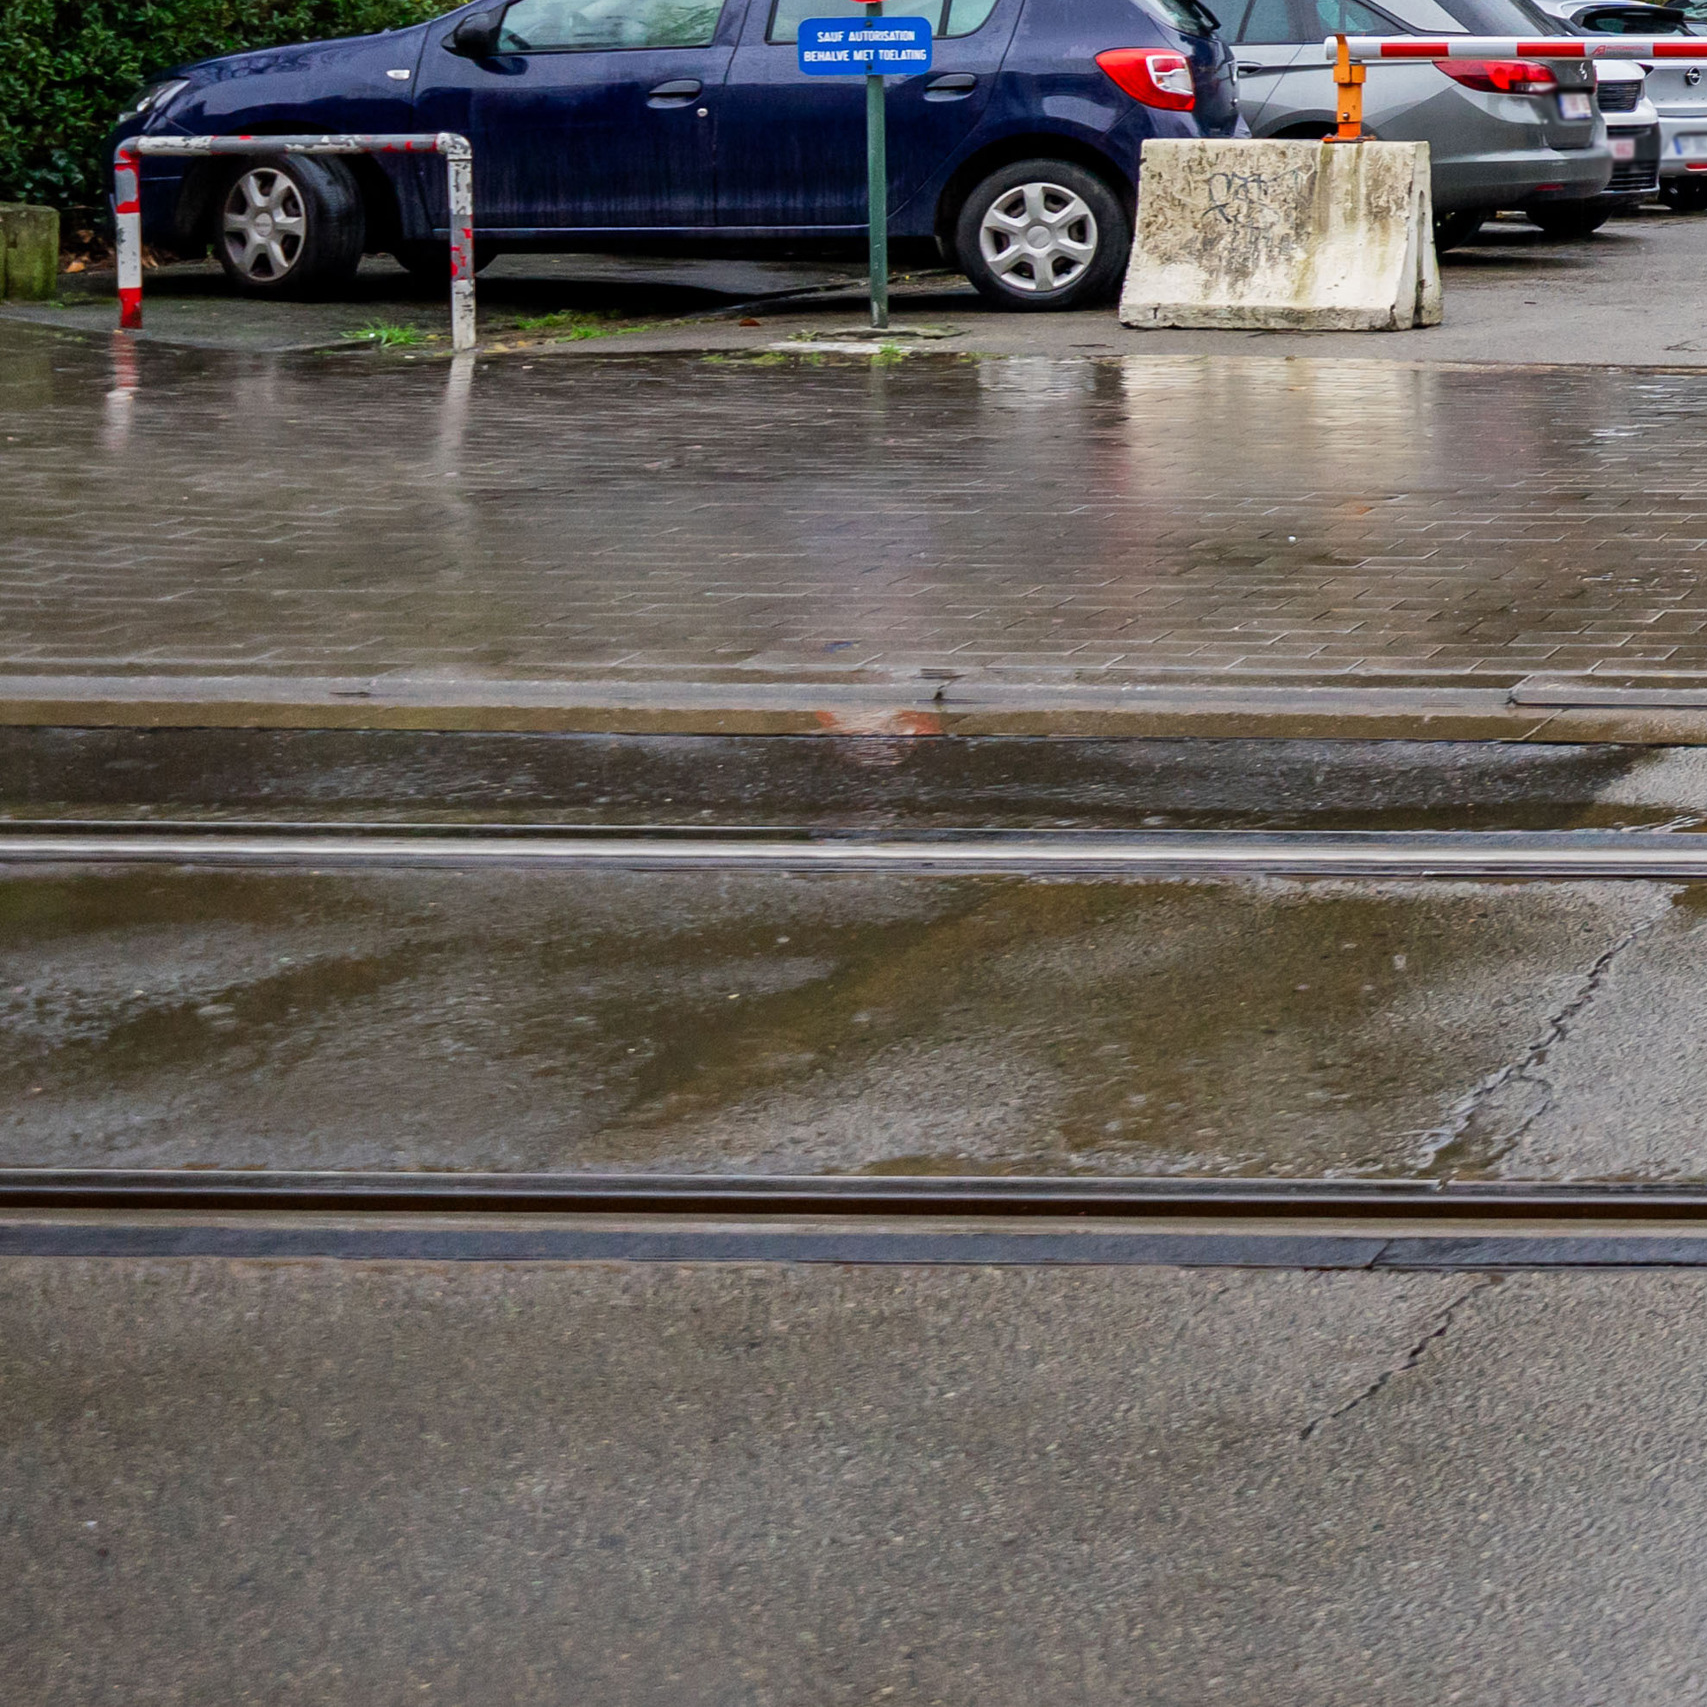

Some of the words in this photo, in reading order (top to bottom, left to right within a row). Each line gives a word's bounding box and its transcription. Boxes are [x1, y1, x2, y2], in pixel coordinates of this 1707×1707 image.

[817, 31, 843, 43] SAUF
[848, 30, 916, 42] AUTORISATION
[803, 50, 850, 62] BEHALVE
[853, 49, 874, 61] MET
[878, 49, 927, 61] TOELATING
